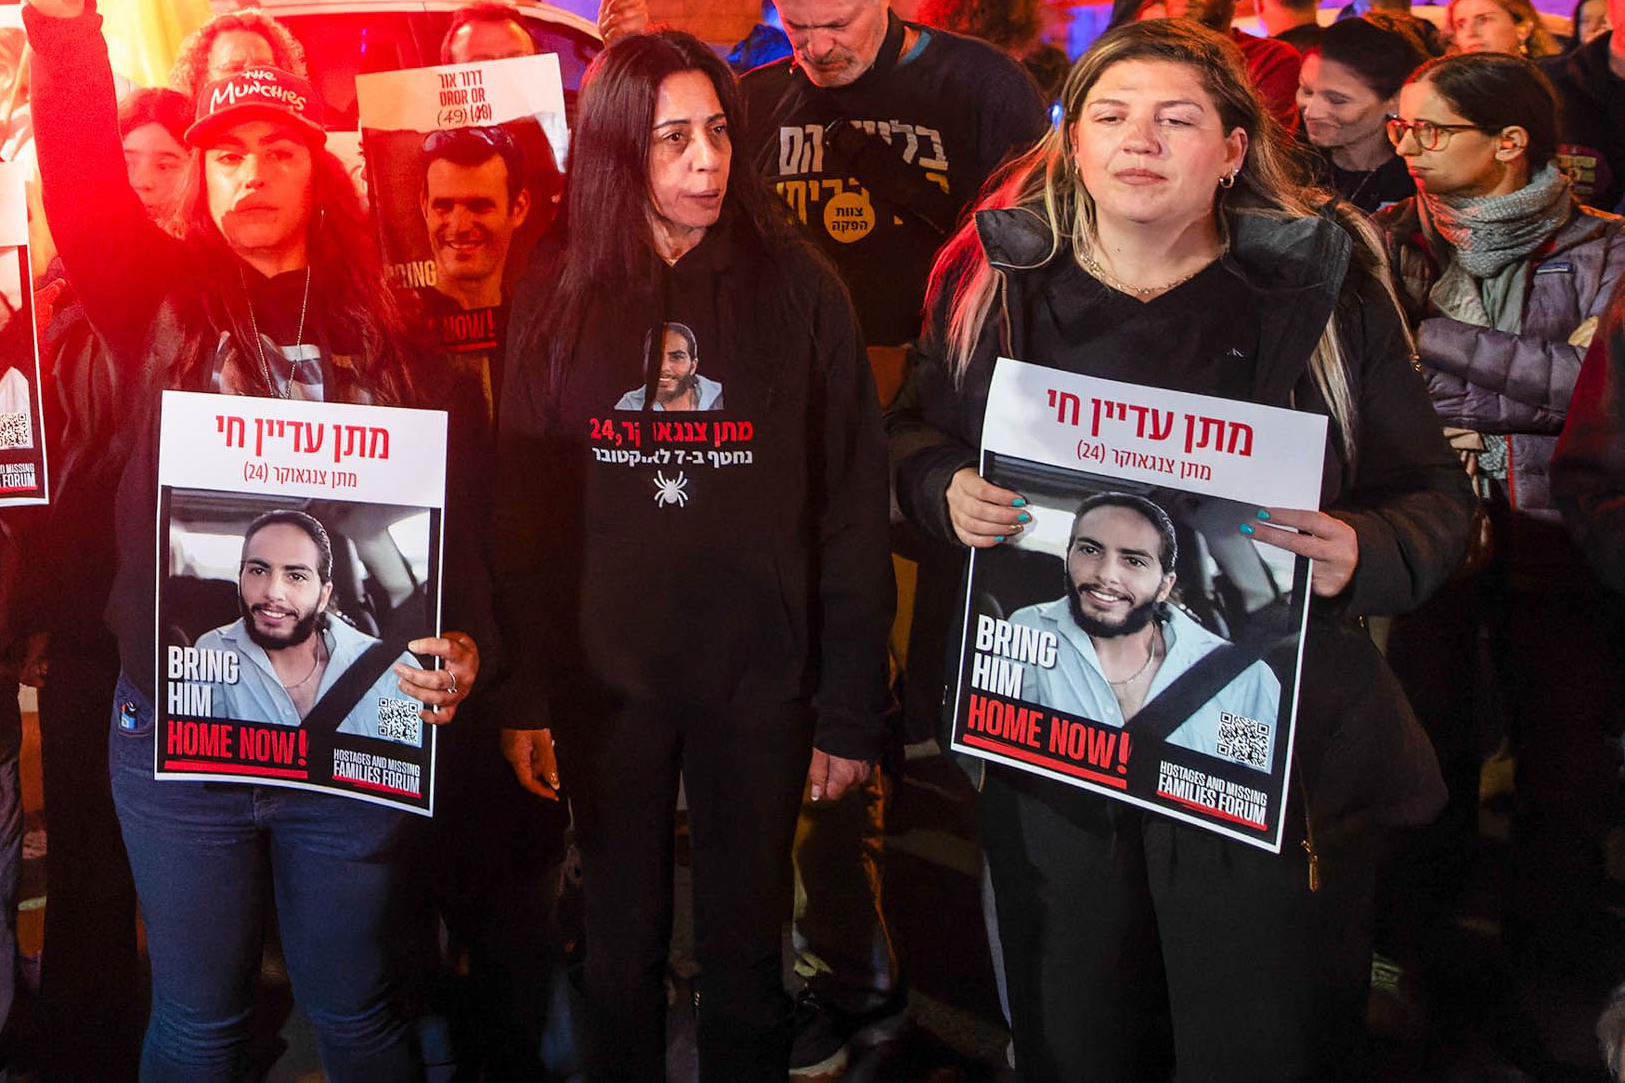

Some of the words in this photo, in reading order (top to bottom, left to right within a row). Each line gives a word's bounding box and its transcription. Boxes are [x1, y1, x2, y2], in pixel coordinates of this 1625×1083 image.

[437, 73, 457, 89] אור
[459, 69, 483, 87] דרור
[439, 89, 468, 106] DROR
[470, 87, 486, 103] OR
[437, 107, 467, 126] (49)
[836, 206, 864, 217] צוות
[831, 220, 868, 234] הפקה
[442, 308, 495, 341] NOW!
[1047, 389, 1080, 426] חי
[1091, 397, 1175, 441] עדיין
[215, 415, 245, 448] חי
[255, 418, 324, 457] עדיין
[332, 424, 390, 463] מתן
[713, 421, 754, 448] מתן
[1184, 414, 1254, 457] מתן
[675, 450, 705, 465] ב-7
[707, 450, 753, 468] נחטף
[1076, 439, 1106, 464] (24)
[1112, 448, 1175, 474] צנגאוקר
[2, 472, 35, 488] FORUM
[5, 463, 35, 474] MISSING
[243, 461, 269, 483] (24)
[273, 466, 326, 485] צנגאוקר
[331, 470, 357, 489] מתן
[1180, 460, 1211, 480] מתן
[975, 614, 1058, 669] BRING
[168, 645, 239, 685] BRING
[971, 652, 1025, 700] HIM
[168, 681, 212, 717] HIM
[167, 720, 233, 758] HOME
[239, 726, 308, 766] NOW!
[967, 694, 1044, 748] HOME
[1049, 716, 1132, 774] NOW!
[333, 748, 371, 766] HOSTAGES
[372, 755, 387, 769] AND
[387, 758, 421, 776] MISSING
[333, 760, 380, 784] FAMILIES
[382, 769, 420, 794] FORUM
[1160, 760, 1206, 787] HOSTAGES
[1206, 775, 1225, 792] AND
[1226, 781, 1268, 806] MISSING
[1158, 774, 1216, 809] FAMILIES
[1218, 793, 1267, 825] FORUM
